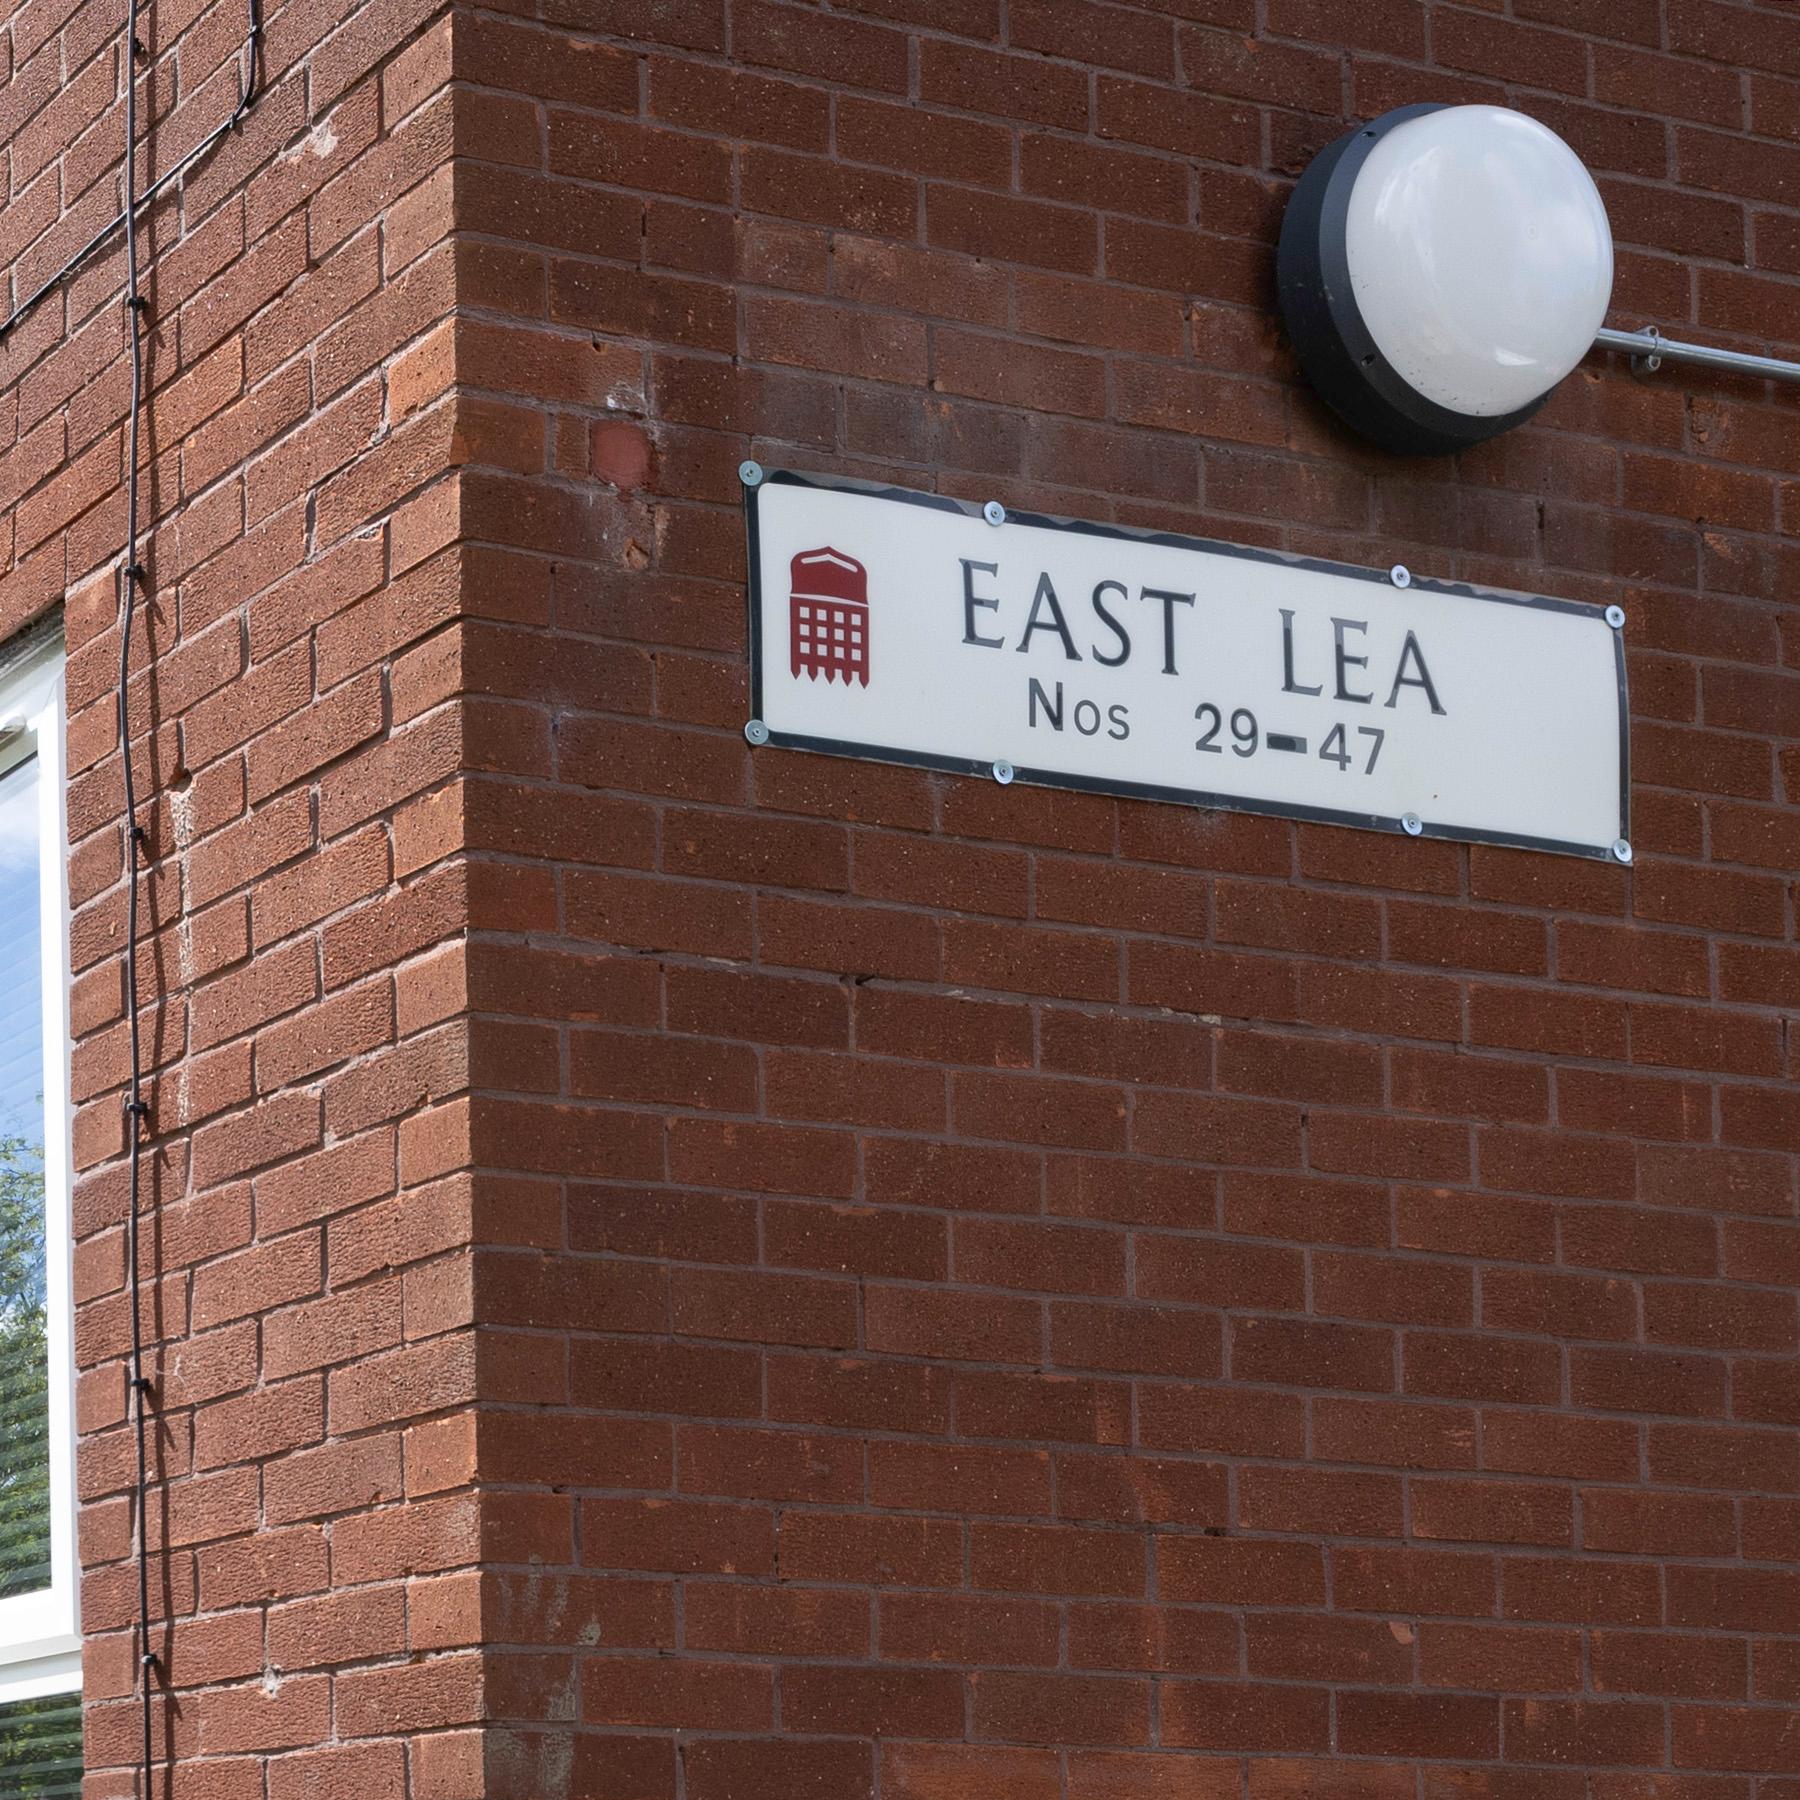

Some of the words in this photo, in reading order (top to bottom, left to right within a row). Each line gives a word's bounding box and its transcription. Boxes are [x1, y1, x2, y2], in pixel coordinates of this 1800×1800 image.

[959, 558, 1196, 676] EAST
[1278, 608, 1447, 716] LEA
[1029, 677, 1131, 741] Nos
